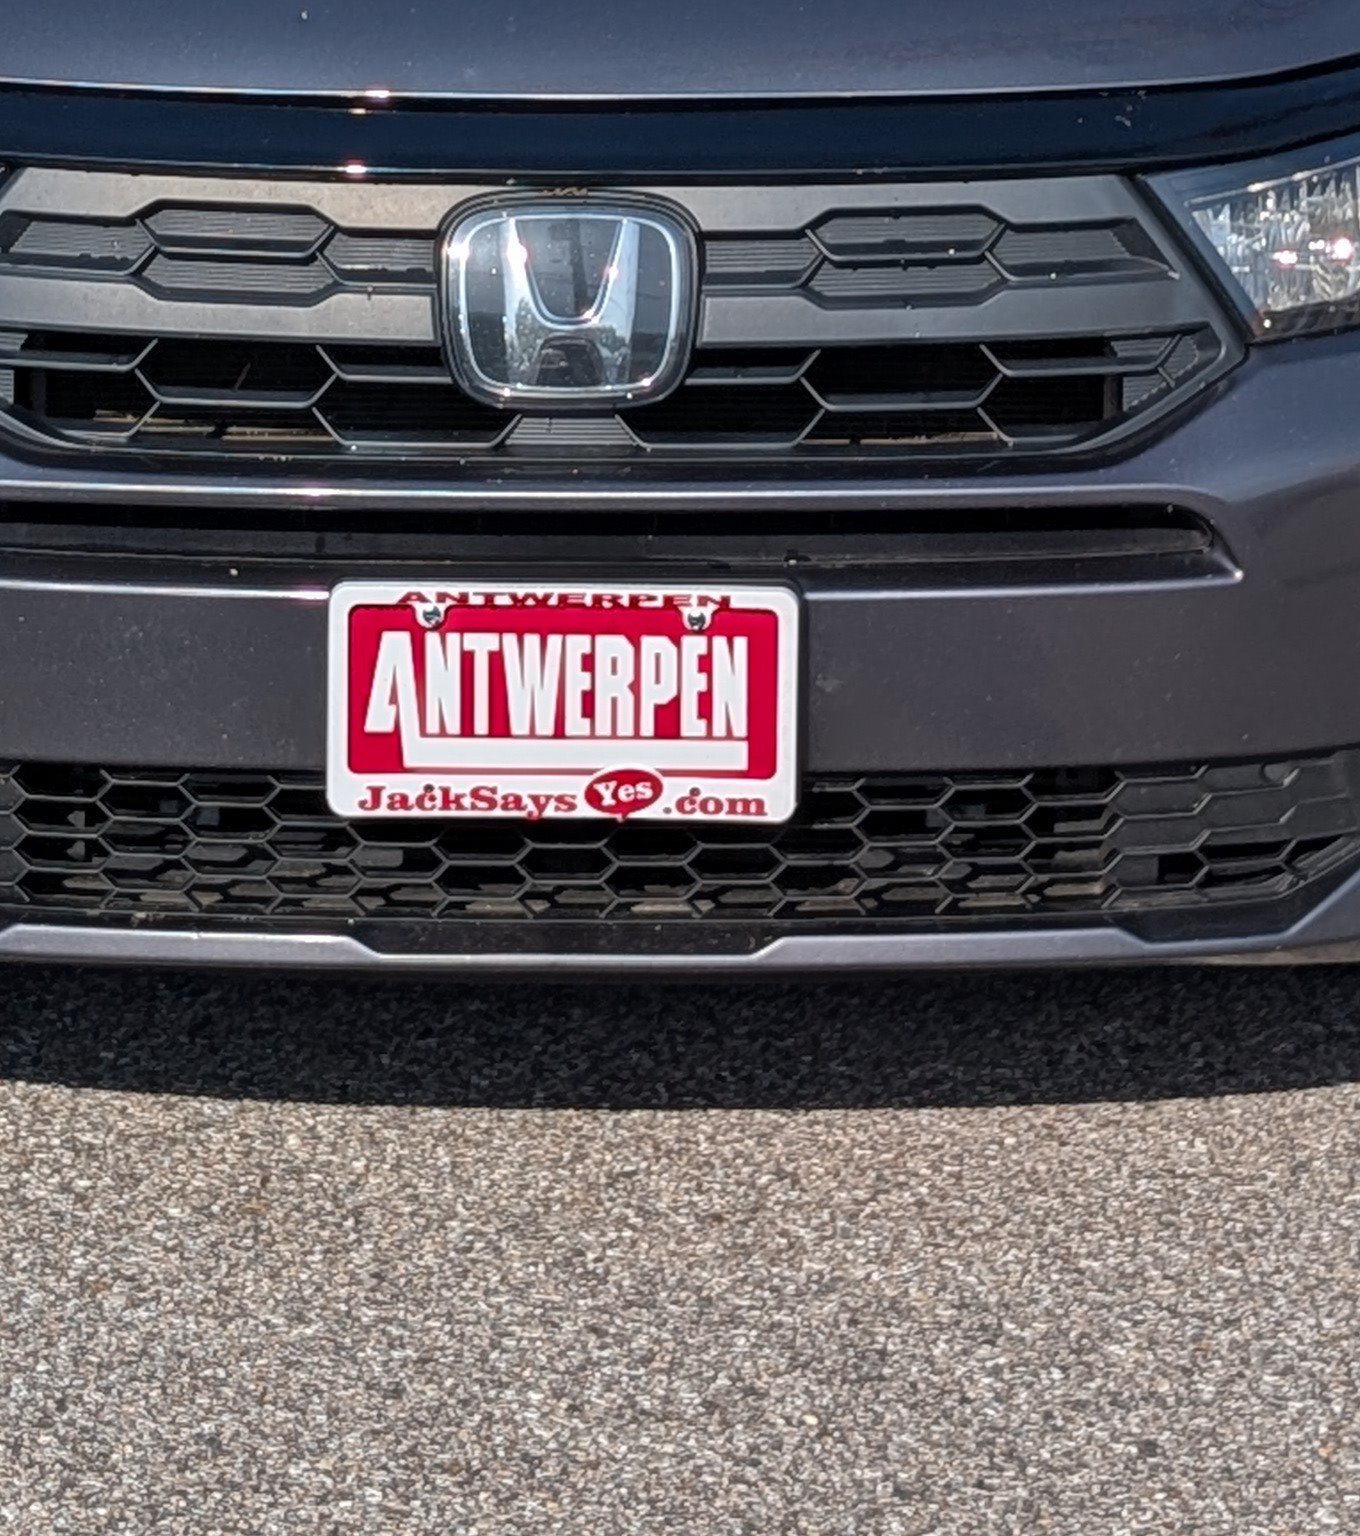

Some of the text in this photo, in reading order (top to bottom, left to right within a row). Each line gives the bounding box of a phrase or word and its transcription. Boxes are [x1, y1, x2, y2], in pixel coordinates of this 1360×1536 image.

[363, 630, 750, 740] ANTWERPEN
[356, 783, 578, 819] JackSays
[593, 776, 654, 805] Yes
